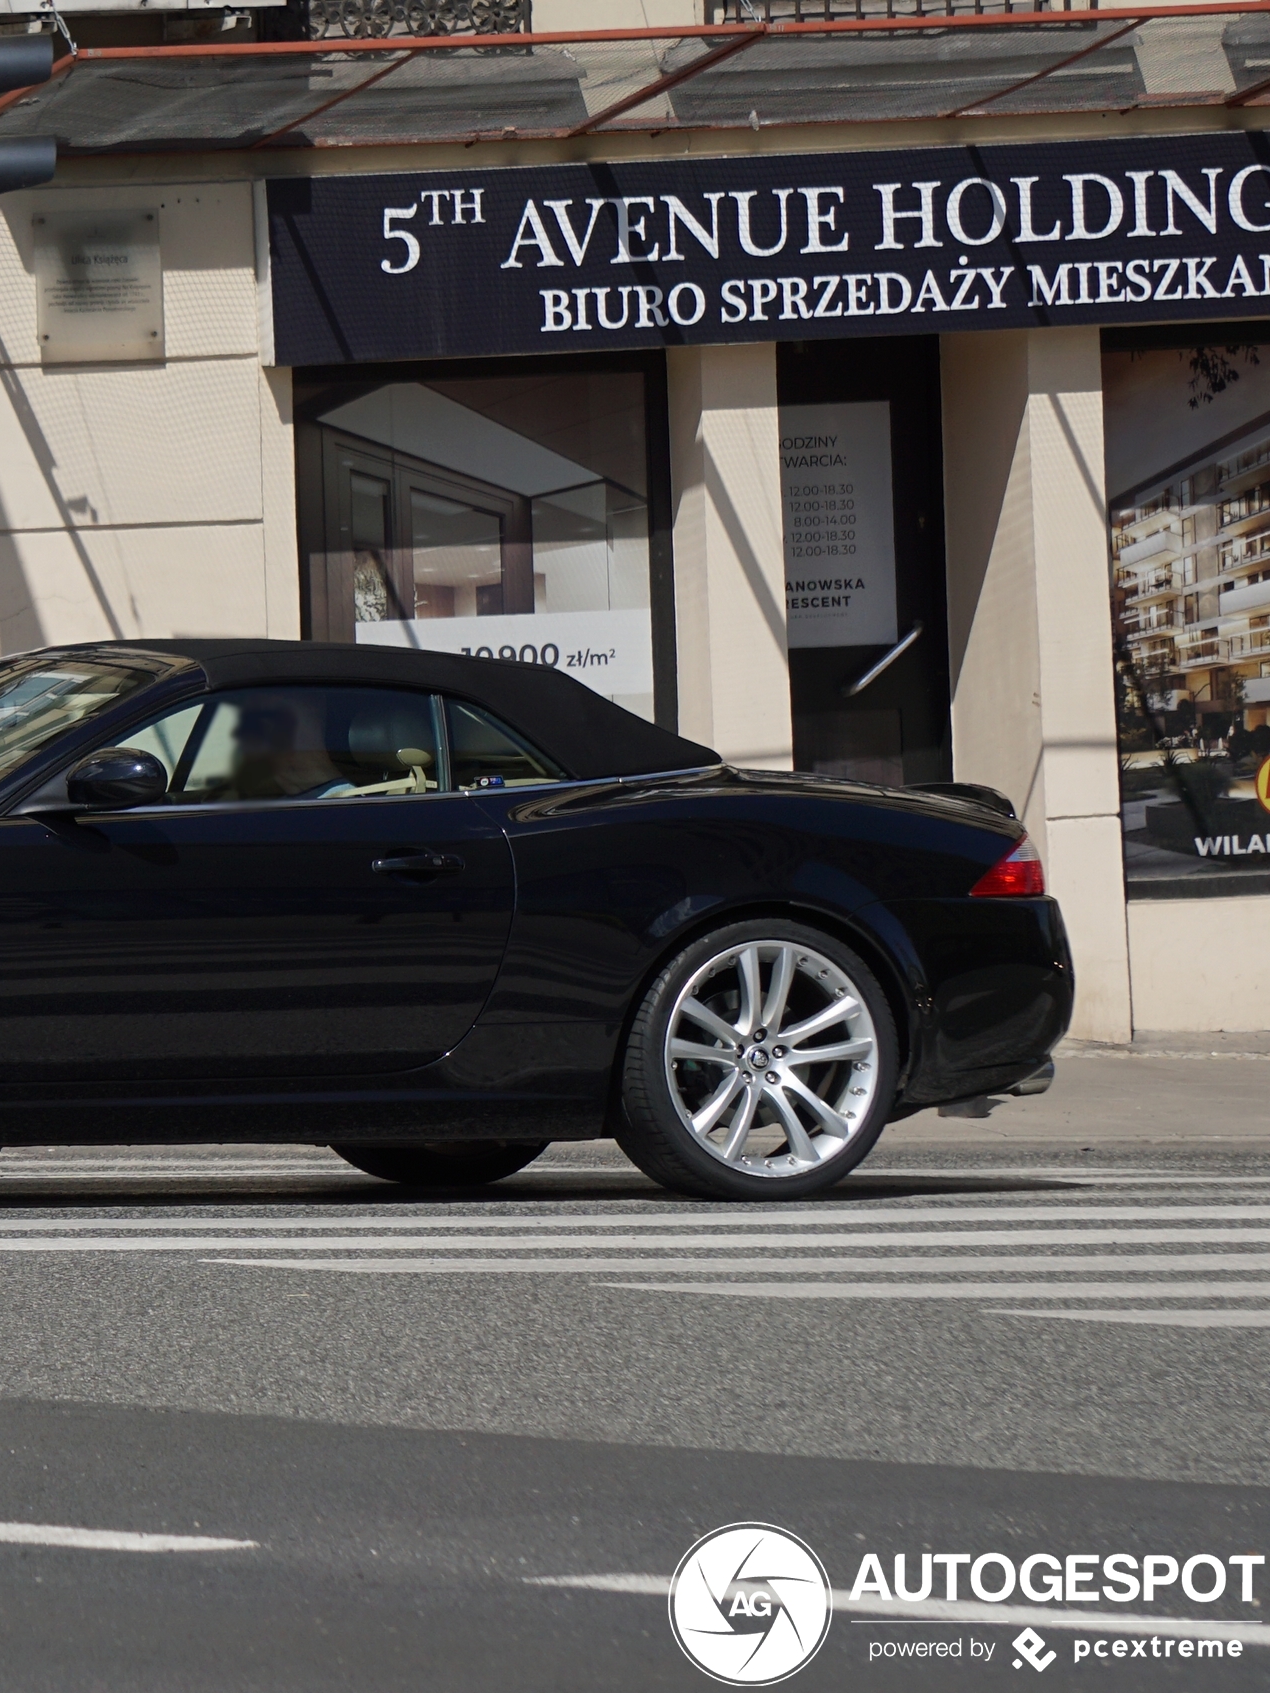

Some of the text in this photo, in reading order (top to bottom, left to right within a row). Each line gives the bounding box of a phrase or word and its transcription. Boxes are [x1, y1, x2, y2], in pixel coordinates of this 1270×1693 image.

[380, 164, 1270, 275] 5TH AVENUE HOLDING
[538, 282, 707, 333] BIURO
[720, 255, 1016, 324] SPRZEDAŻY
[779, 435, 838, 451] ODZINY
[780, 453, 847, 469] WARCIA:
[789, 483, 854, 498] 12.00-18.30
[793, 514, 857, 528] 8.00-14.00
[1194, 833, 1270, 857] WILA
